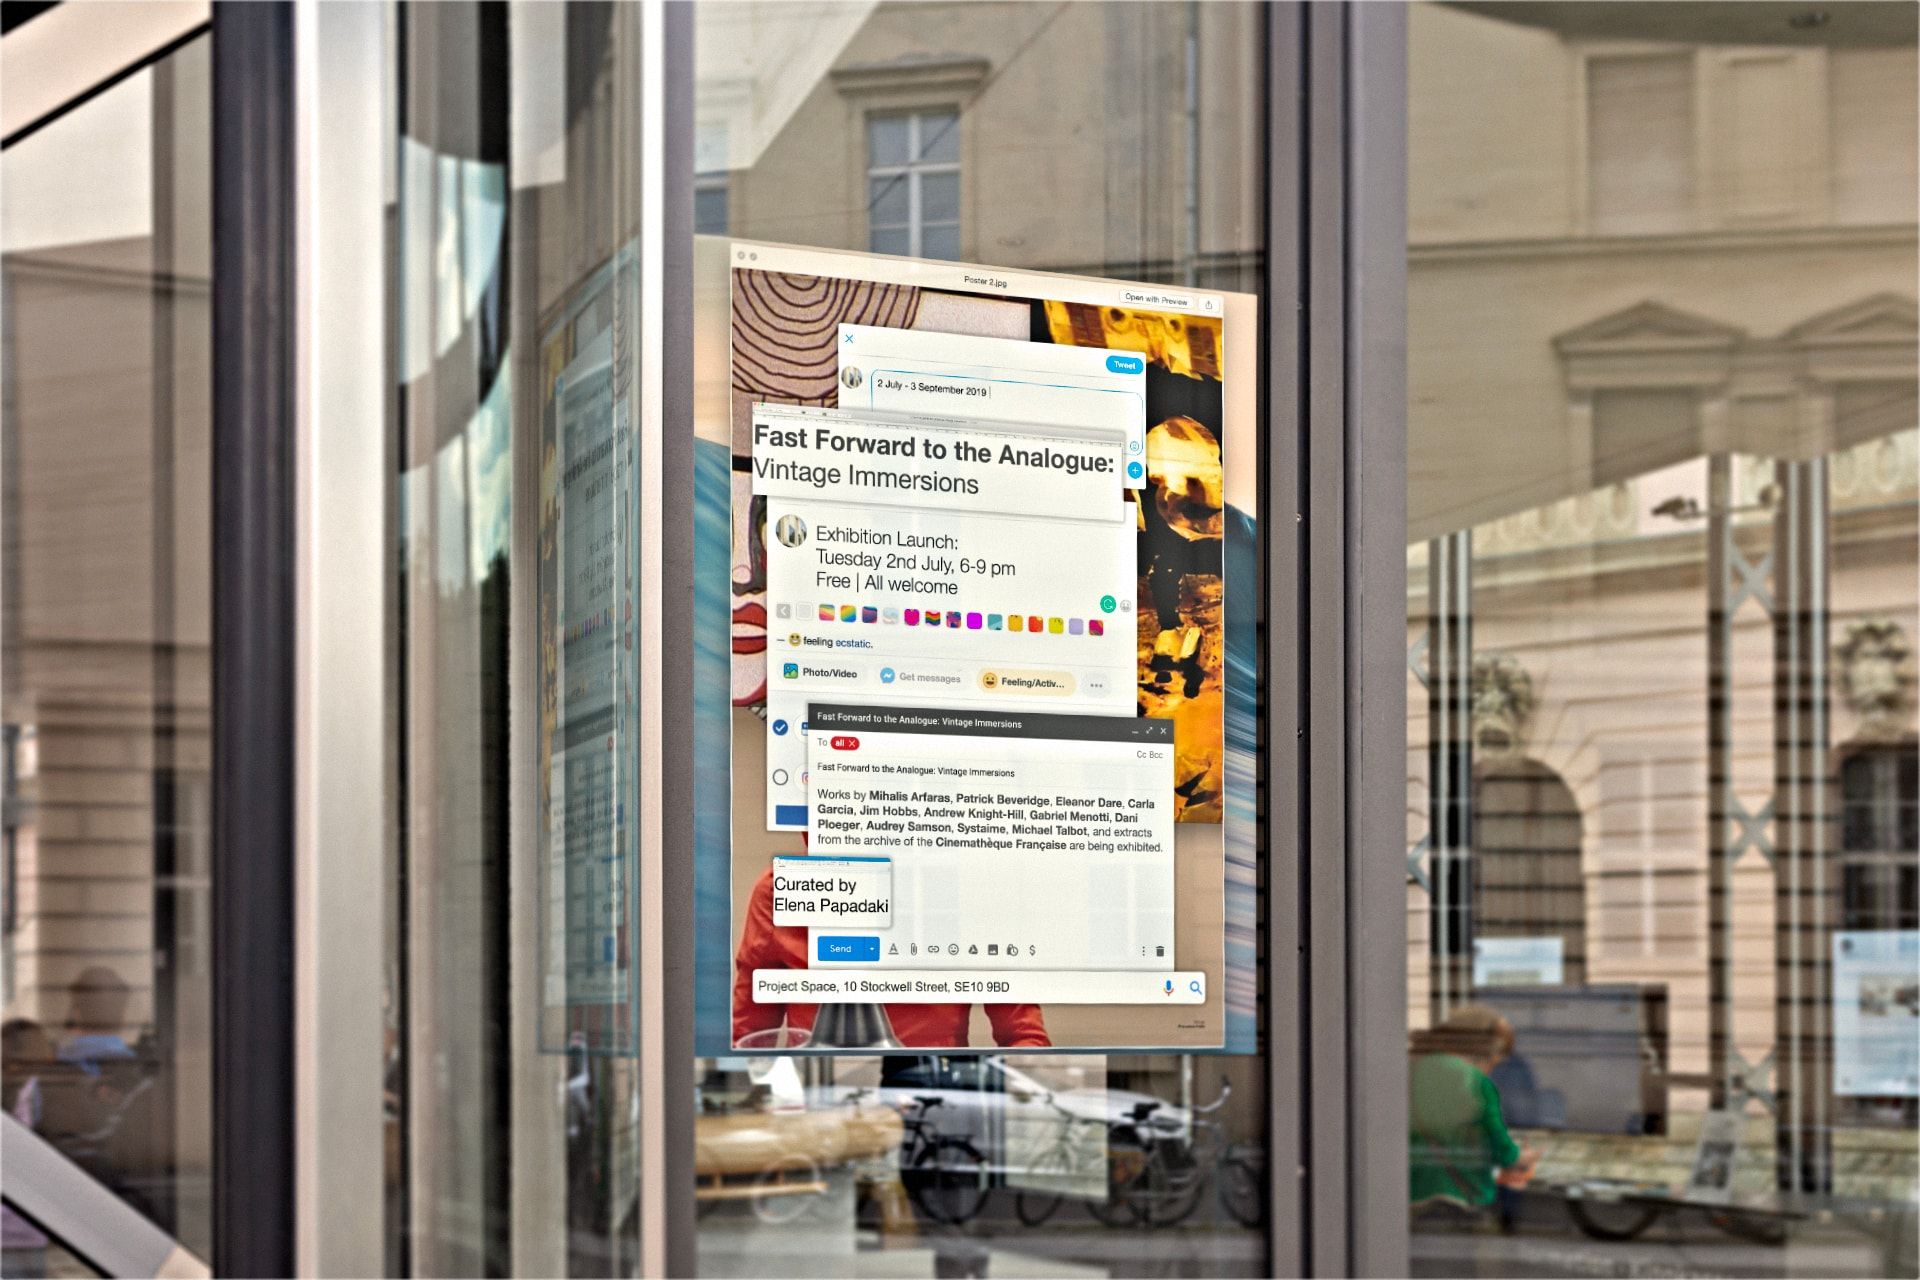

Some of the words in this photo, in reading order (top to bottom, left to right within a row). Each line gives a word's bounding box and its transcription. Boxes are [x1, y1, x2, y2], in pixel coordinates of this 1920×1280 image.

[964, 275, 988, 285] Poster
[988, 278, 1008, 289] 2.jpg
[1125, 292, 1144, 302] Open
[1145, 295, 1160, 303] with
[1161, 296, 1188, 306] Preview
[1114, 360, 1136, 370] Tweet
[877, 378, 884, 388] 2
[885, 379, 903, 392] July
[910, 381, 917, 391] 3
[918, 382, 965, 395] September
[965, 386, 987, 397] 2019
[754, 423, 808, 449] Fast
[815, 428, 916, 457] Forward
[922, 438, 947, 460] to
[953, 440, 992, 464] the
[998, 444, 1114, 475] Analogue:
[754, 456, 841, 489] Vintage
[849, 464, 979, 495] Immersions
[816, 525, 892, 546] Exhibition
[897, 530, 958, 550] Launch:
[816, 547, 882, 571] Tuesday
[886, 553, 917, 570] 2nd
[921, 555, 955, 576] July,
[959, 557, 987, 575] 6-9
[991, 563, 1016, 579] pm
[816, 571, 851, 589] Free
[864, 574, 883, 591] All
[887, 577, 959, 595] welcome
[803, 636, 834, 649] feeling
[835, 639, 874, 649] ecstatic.
[802, 667, 858, 679] Photo/Video
[899, 671, 916, 682] Get
[916, 674, 961, 685] messages
[817, 711, 836, 721] Fast
[837, 712, 871, 723] Forward
[873, 715, 882, 723] to
[883, 714, 898, 724] the
[898, 715, 940, 727] Analogue:
[941, 717, 974, 729] Vintage
[974, 718, 1023, 729] Immersions
[816, 737, 828, 747] To
[834, 738, 846, 748] all
[1136, 750, 1147, 759] Cc
[1149, 750, 1164, 759] Bcc
[817, 762, 835, 772] Fast
[837, 763, 870, 773] Forward
[871, 764, 881, 773] to
[881, 764, 895, 774] the
[896, 765, 936, 777] Analogue:
[937, 766, 968, 778] Vintage
[969, 768, 1016, 778] Immersions
[817, 788, 851, 800] Works
[853, 790, 867, 801] by
[869, 790, 909, 802] Mihalis
[910, 791, 954, 804] Arfaras,
[956, 793, 994, 804] Patrick
[997, 794, 1053, 808] Beveridge,
[1055, 796, 1096, 808] Eleanor
[1098, 797, 1125, 808] Dare,
[1127, 798, 1155, 809] Carla
[817, 803, 857, 816] Garcia,
[859, 804, 880, 816] Jim
[882, 805, 921, 818] Hobbs,
[923, 806, 966, 818] Andrew
[968, 807, 1027, 821] Knight-Hill,
[1029, 809, 1068, 821] Gabriel
[1069, 811, 1112, 824] Menotti,
[1114, 812, 1138, 823] Dani
[817, 818, 863, 831] Ploeger,
[865, 820, 905, 833] Audrey
[907, 821, 954, 834] Samson,
[957, 822, 1009, 835] Systaime,
[1012, 823, 1053, 836] Michael
[1055, 825, 1090, 838] Talbot,
[1092, 826, 1111, 837] and
[1113, 828, 1153, 838] extracts
[817, 833, 842, 845] from
[844, 834, 861, 845] the
[863, 835, 902, 846] archive
[903, 836, 915, 847] of
[916, 836, 933, 847] the
[935, 836, 1013, 851] Cinemathèque
[1015, 838, 1067, 852] Française
[1069, 842, 1086, 851] are
[1087, 840, 1115, 854] being
[1116, 841, 1163, 853] exhibited.
[774, 876, 834, 892] Curated
[838, 878, 857, 896] by
[774, 897, 816, 913] Elena
[820, 898, 889, 916] Papadaki
[830, 944, 852, 953] Send
[758, 980, 798, 995] Project
[801, 980, 840, 994] Space,
[844, 980, 857, 992] 10
[860, 980, 912, 992] Stockwell
[915, 980, 951, 993] Street,
[954, 981, 984, 993] SE10
[986, 981, 1010, 993] 9BD
